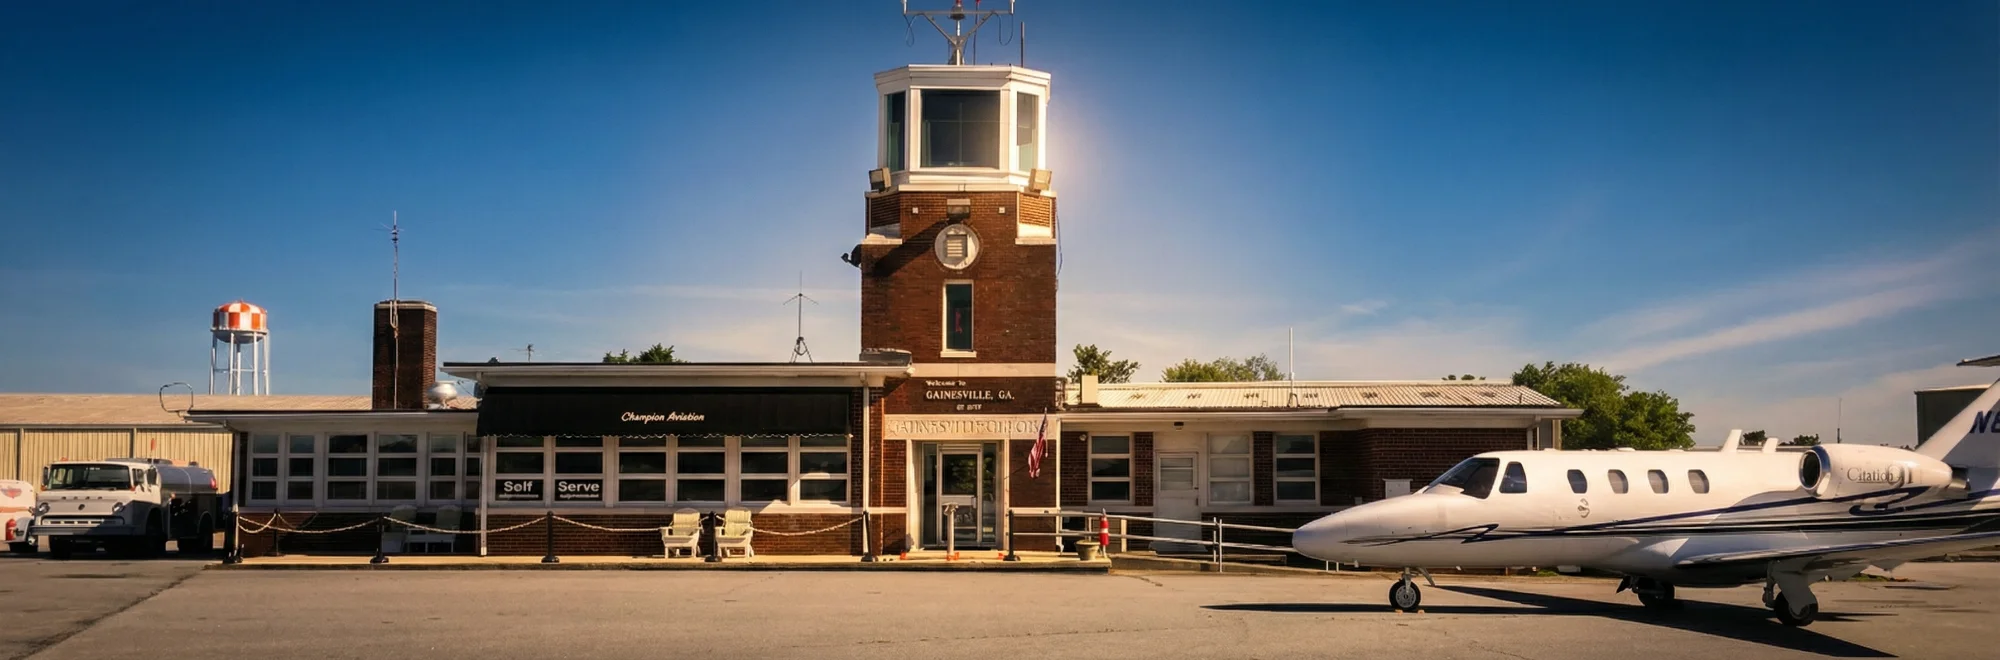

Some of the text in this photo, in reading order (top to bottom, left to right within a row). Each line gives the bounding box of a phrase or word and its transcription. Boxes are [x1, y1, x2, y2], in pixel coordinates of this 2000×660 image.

[926, 390, 1015, 401] GAINESVILLE, GA.
[621, 411, 705, 425] Champion Aviation
[1847, 467, 1894, 482] Citation
[503, 481, 600, 492] Self Serve
